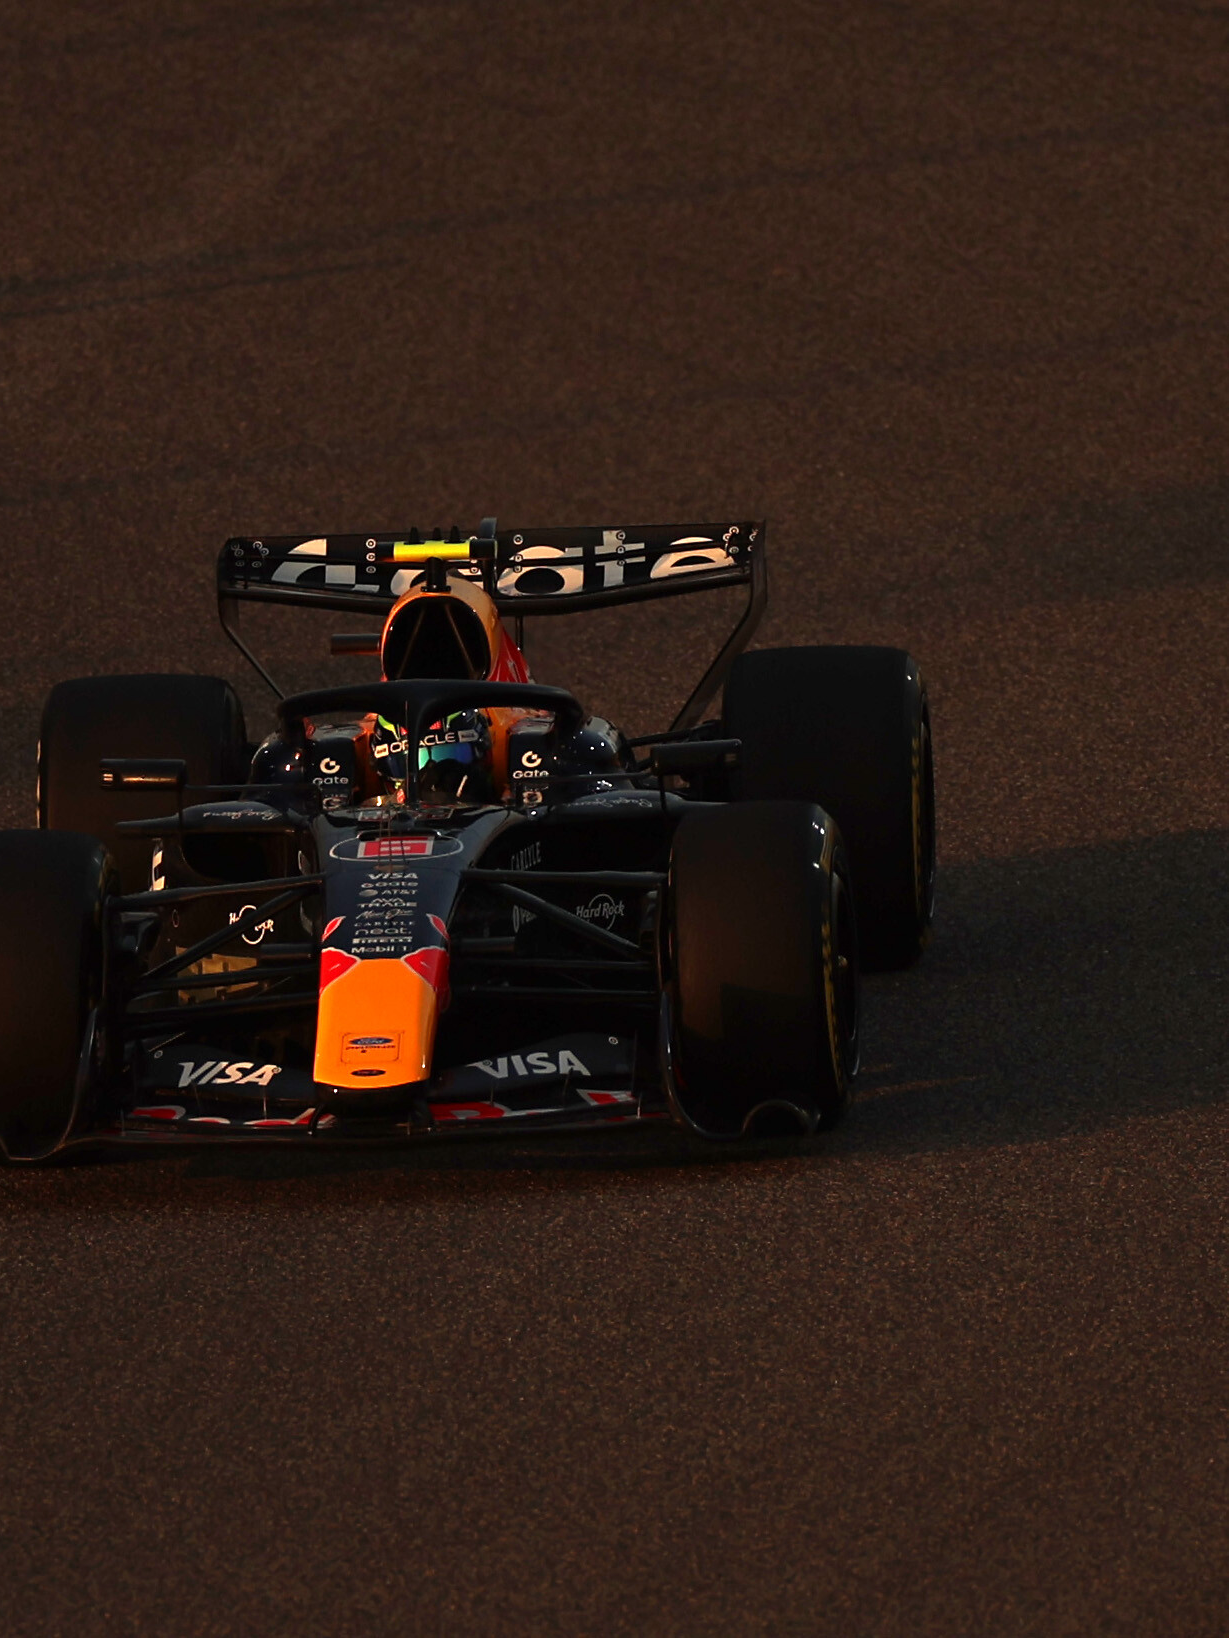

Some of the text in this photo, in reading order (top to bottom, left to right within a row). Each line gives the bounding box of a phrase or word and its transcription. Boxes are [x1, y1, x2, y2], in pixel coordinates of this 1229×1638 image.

[368, 872, 419, 880] VISA
[575, 900, 625, 919] Hard Rock
[351, 945, 395, 953] Mobil
[178, 1060, 277, 1088] VISA
[466, 1050, 591, 1079] VISA
